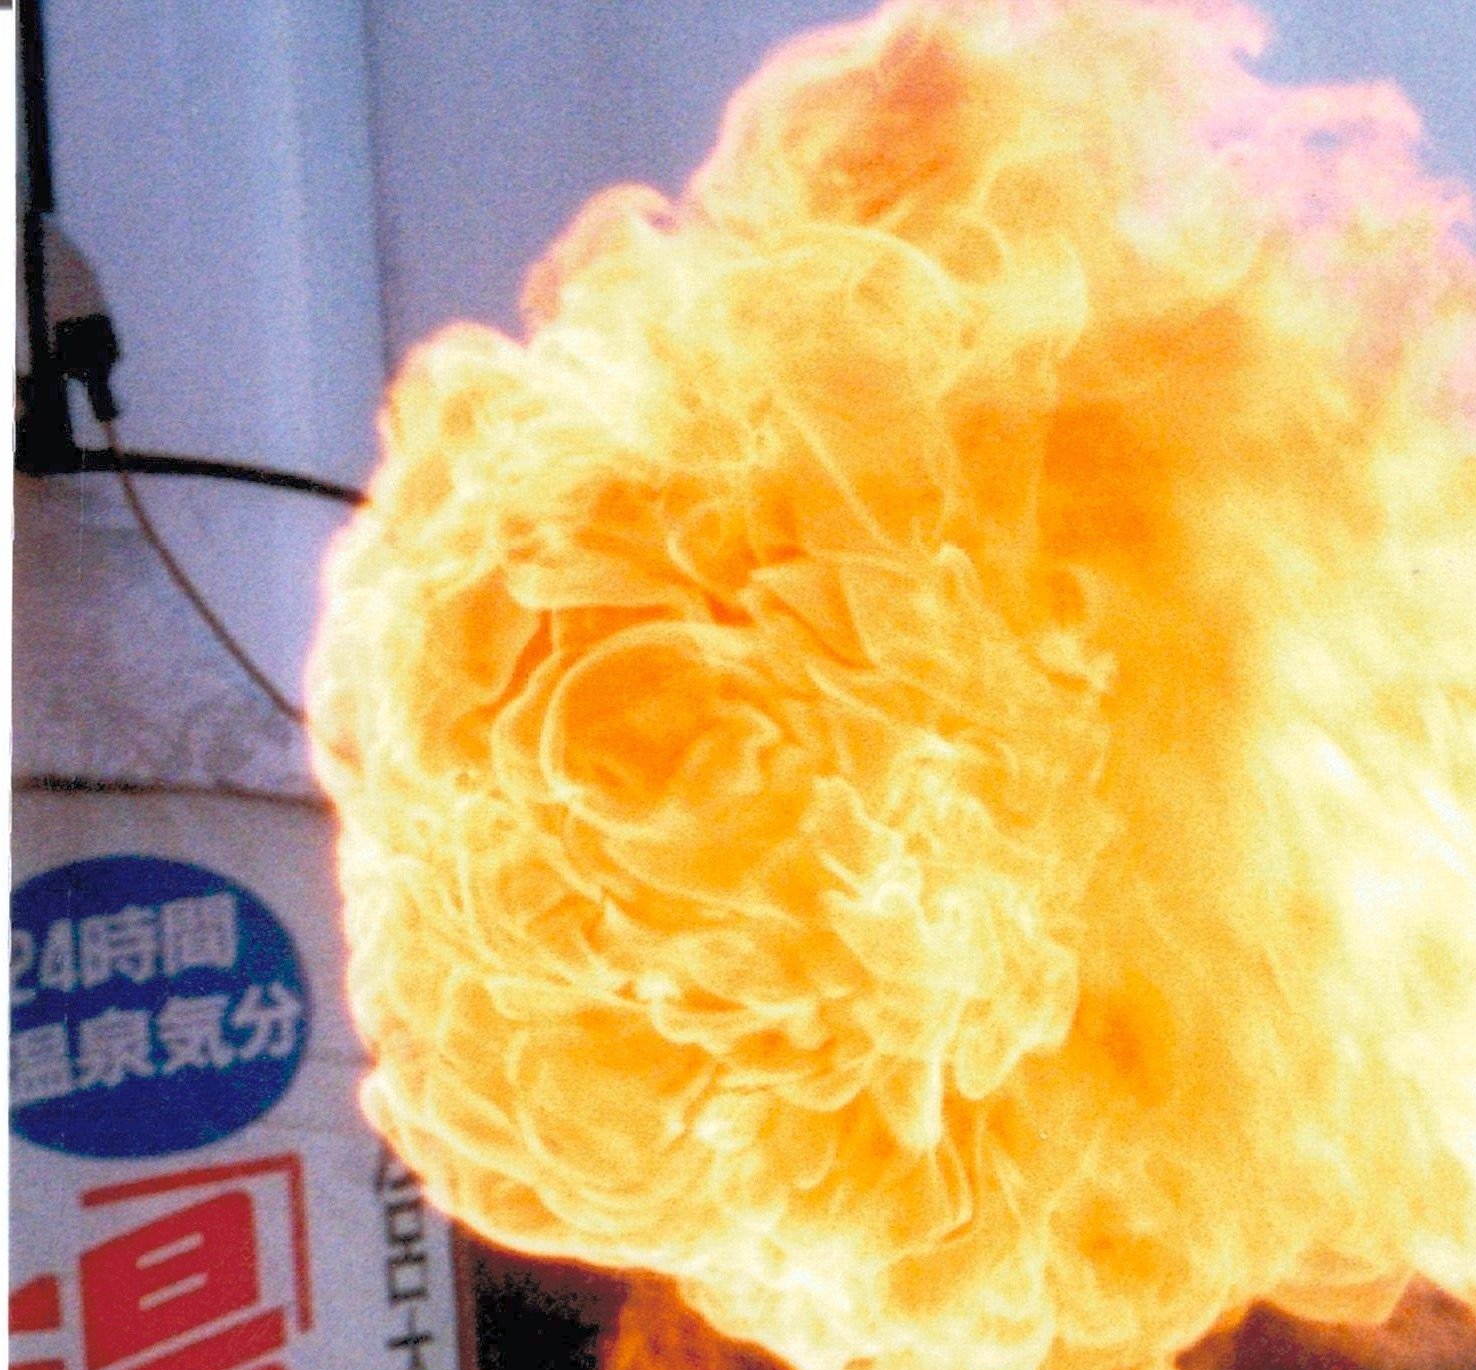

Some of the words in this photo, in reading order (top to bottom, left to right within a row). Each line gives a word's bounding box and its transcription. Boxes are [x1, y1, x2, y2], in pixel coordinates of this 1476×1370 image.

[10, 891, 238, 1007] 24時間
[10, 981, 301, 1098] 温泉気分
